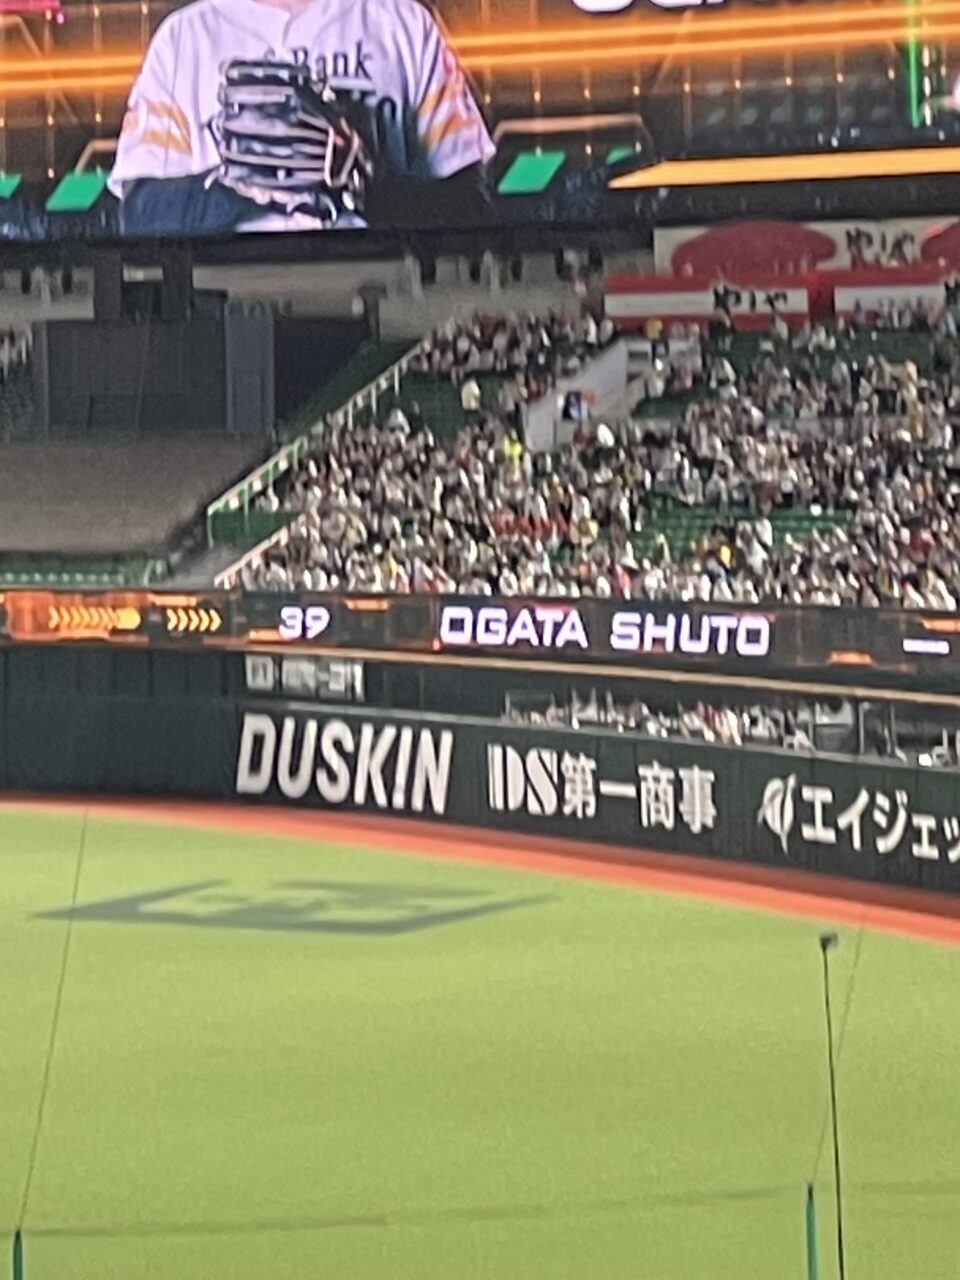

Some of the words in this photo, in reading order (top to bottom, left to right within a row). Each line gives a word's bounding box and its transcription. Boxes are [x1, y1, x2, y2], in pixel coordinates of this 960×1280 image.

[279, 606, 330, 639] 39
[440, 606, 589, 648] OGATA
[610, 612, 770, 657] SHUTO
[236, 713, 454, 814] DUSKIN
